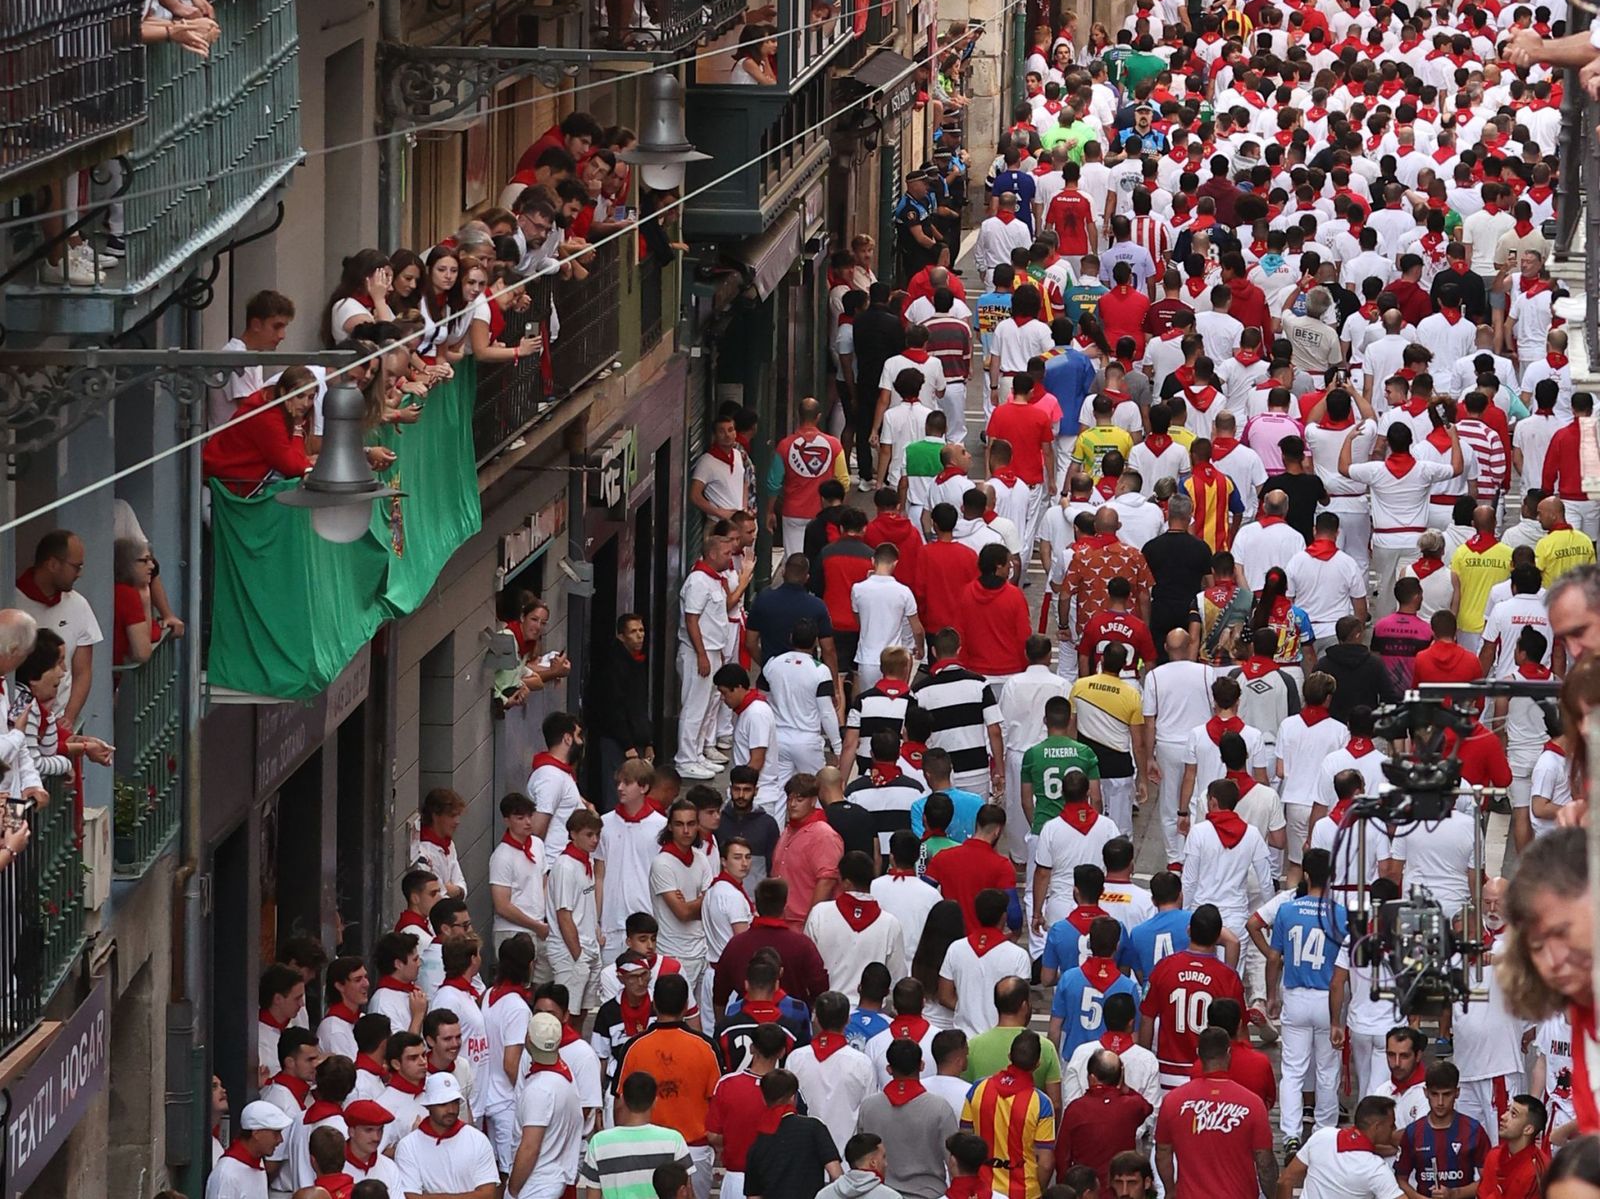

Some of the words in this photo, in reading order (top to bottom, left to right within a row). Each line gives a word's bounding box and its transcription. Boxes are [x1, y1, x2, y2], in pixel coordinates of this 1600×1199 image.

[1295, 328, 1320, 341] BEST
[1465, 557, 1507, 570] SERRADILLA
[1100, 622, 1134, 639] A.PEREA
[1088, 682, 1121, 695] PELIGROS
[1043, 746, 1079, 758] PIZKERRA
[1288, 925, 1326, 970] 14
[1178, 971, 1212, 986] CURRO
[1079, 986, 1104, 1031] 5
[1169, 987, 1213, 1035] 10
[9, 1075, 57, 1178] TEXTIL
[60, 1009, 104, 1115] HOGAR
[1216, 1101, 1250, 1120] YOUR
[1192, 1111, 1241, 1135] IDOLS
[1420, 1170, 1464, 1181] SERANDO
